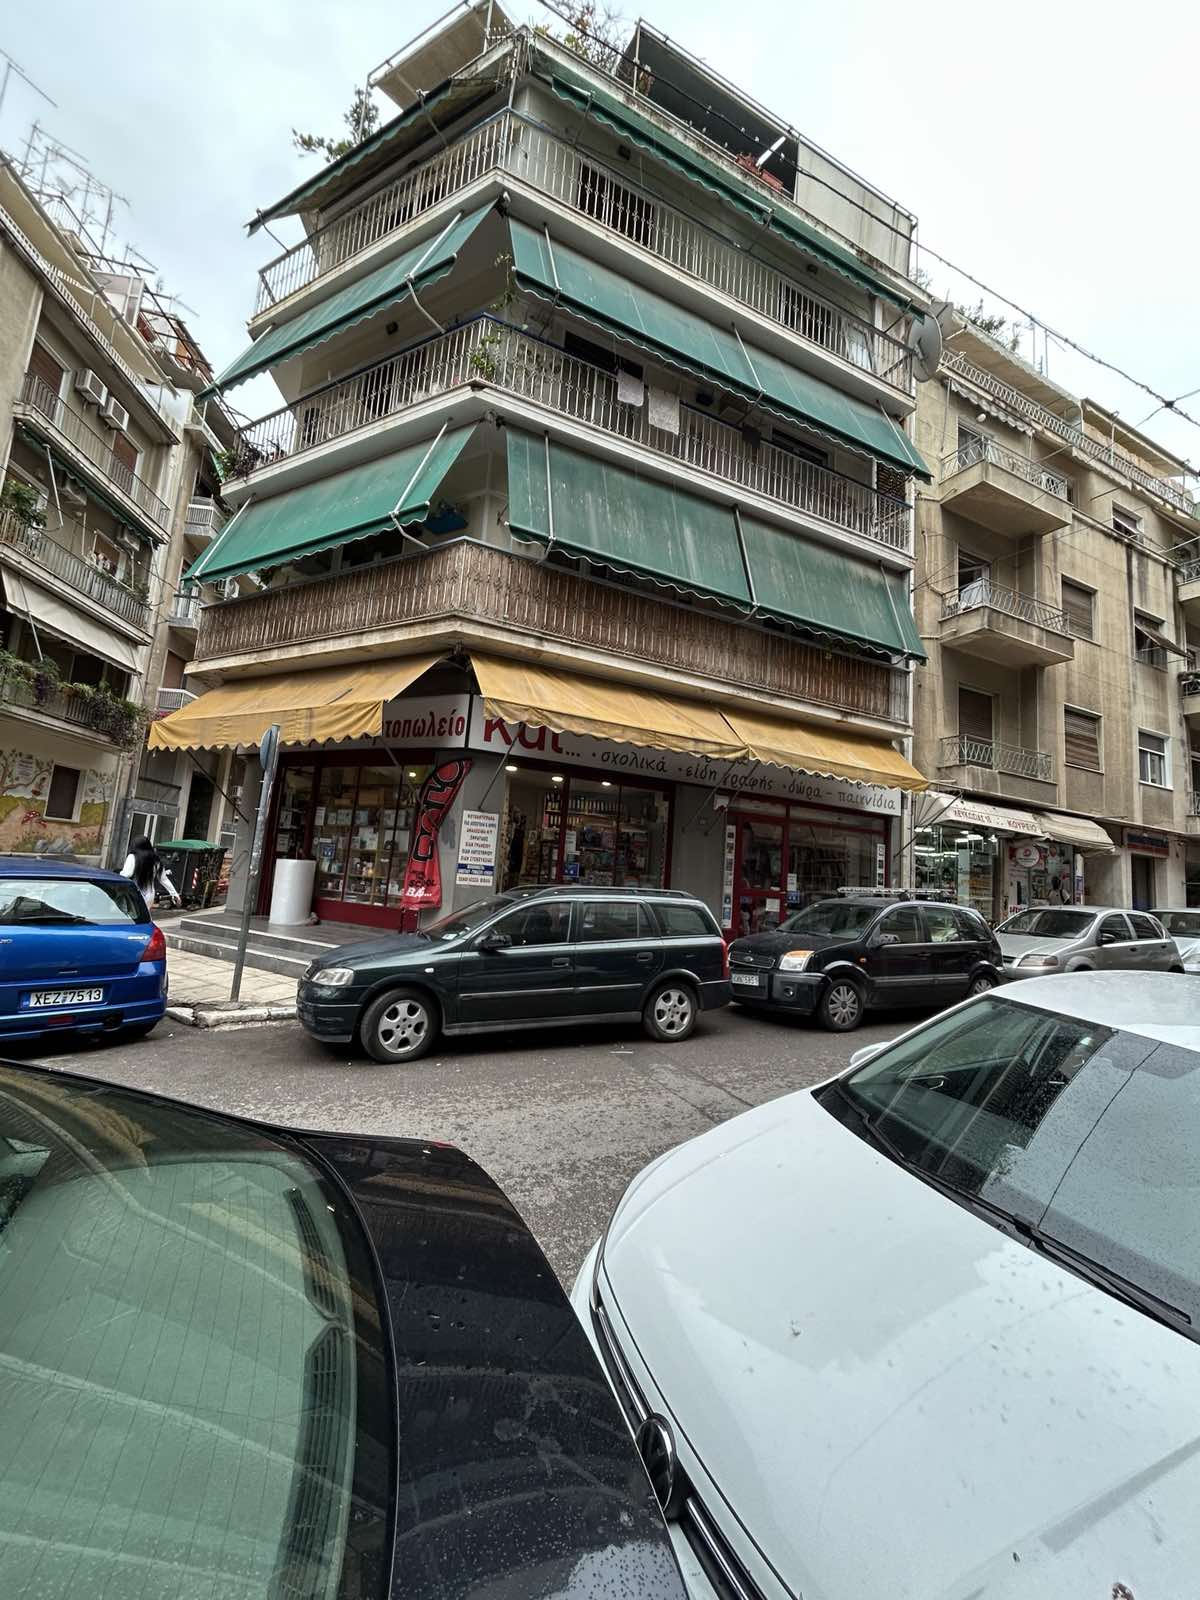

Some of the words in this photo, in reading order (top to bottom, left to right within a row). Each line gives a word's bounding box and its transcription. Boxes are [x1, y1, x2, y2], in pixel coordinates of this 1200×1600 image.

[384, 709, 465, 738] τοπωλείο
[601, 751, 667, 774] σχολικά
[686, 762, 717, 782] είδη
[34, 992, 61, 1006] XEZ
[68, 989, 102, 1002] 7513
